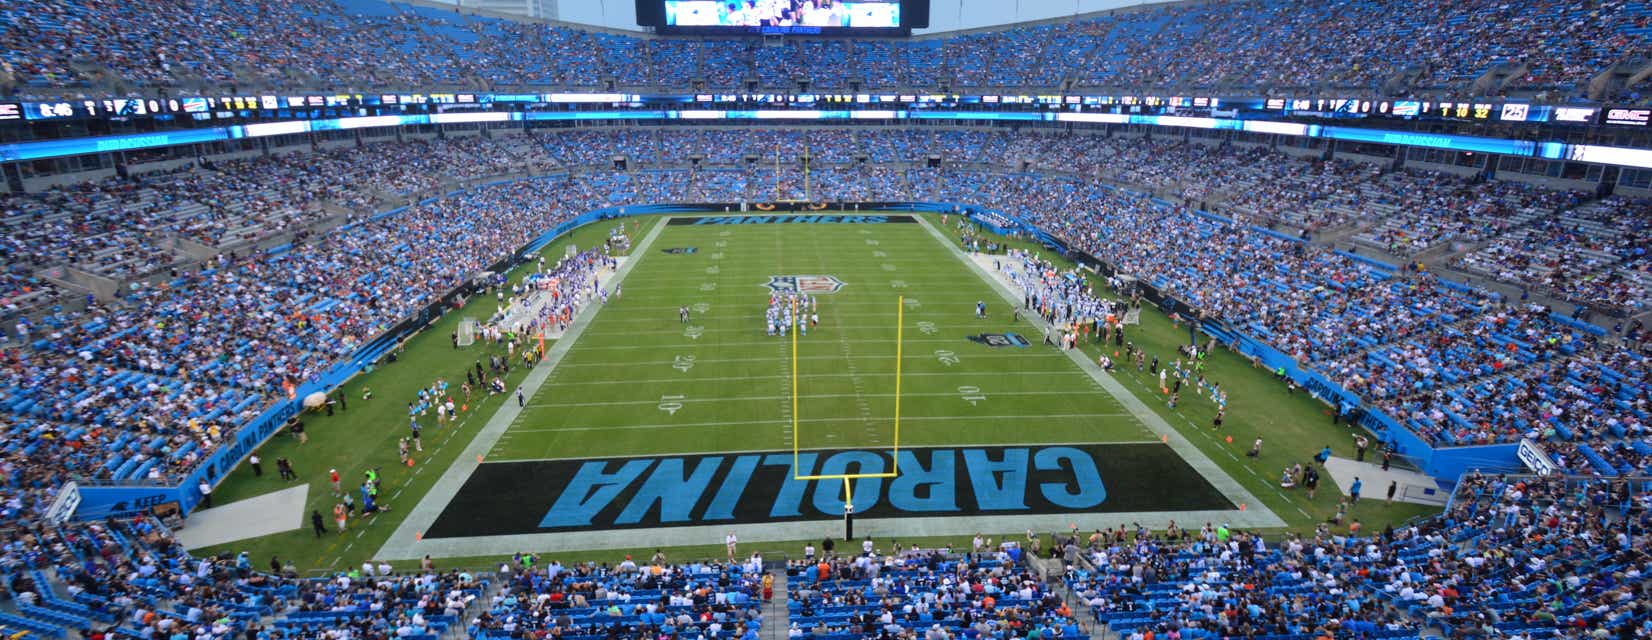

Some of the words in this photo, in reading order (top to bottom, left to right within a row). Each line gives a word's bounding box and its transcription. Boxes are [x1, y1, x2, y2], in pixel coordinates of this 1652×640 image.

[40, 103, 73, 116] 8:46
[149, 100, 159, 112] 0
[169, 99, 179, 111] 0
[1361, 102, 1370, 112] 0
[1379, 102, 1389, 113] 0
[1456, 109, 1469, 118] 10
[1474, 109, 1488, 118] 32
[695, 216, 889, 224] PANTHERS
[1521, 445, 1548, 477] GEICO
[537, 446, 1106, 528] CAROLINA
